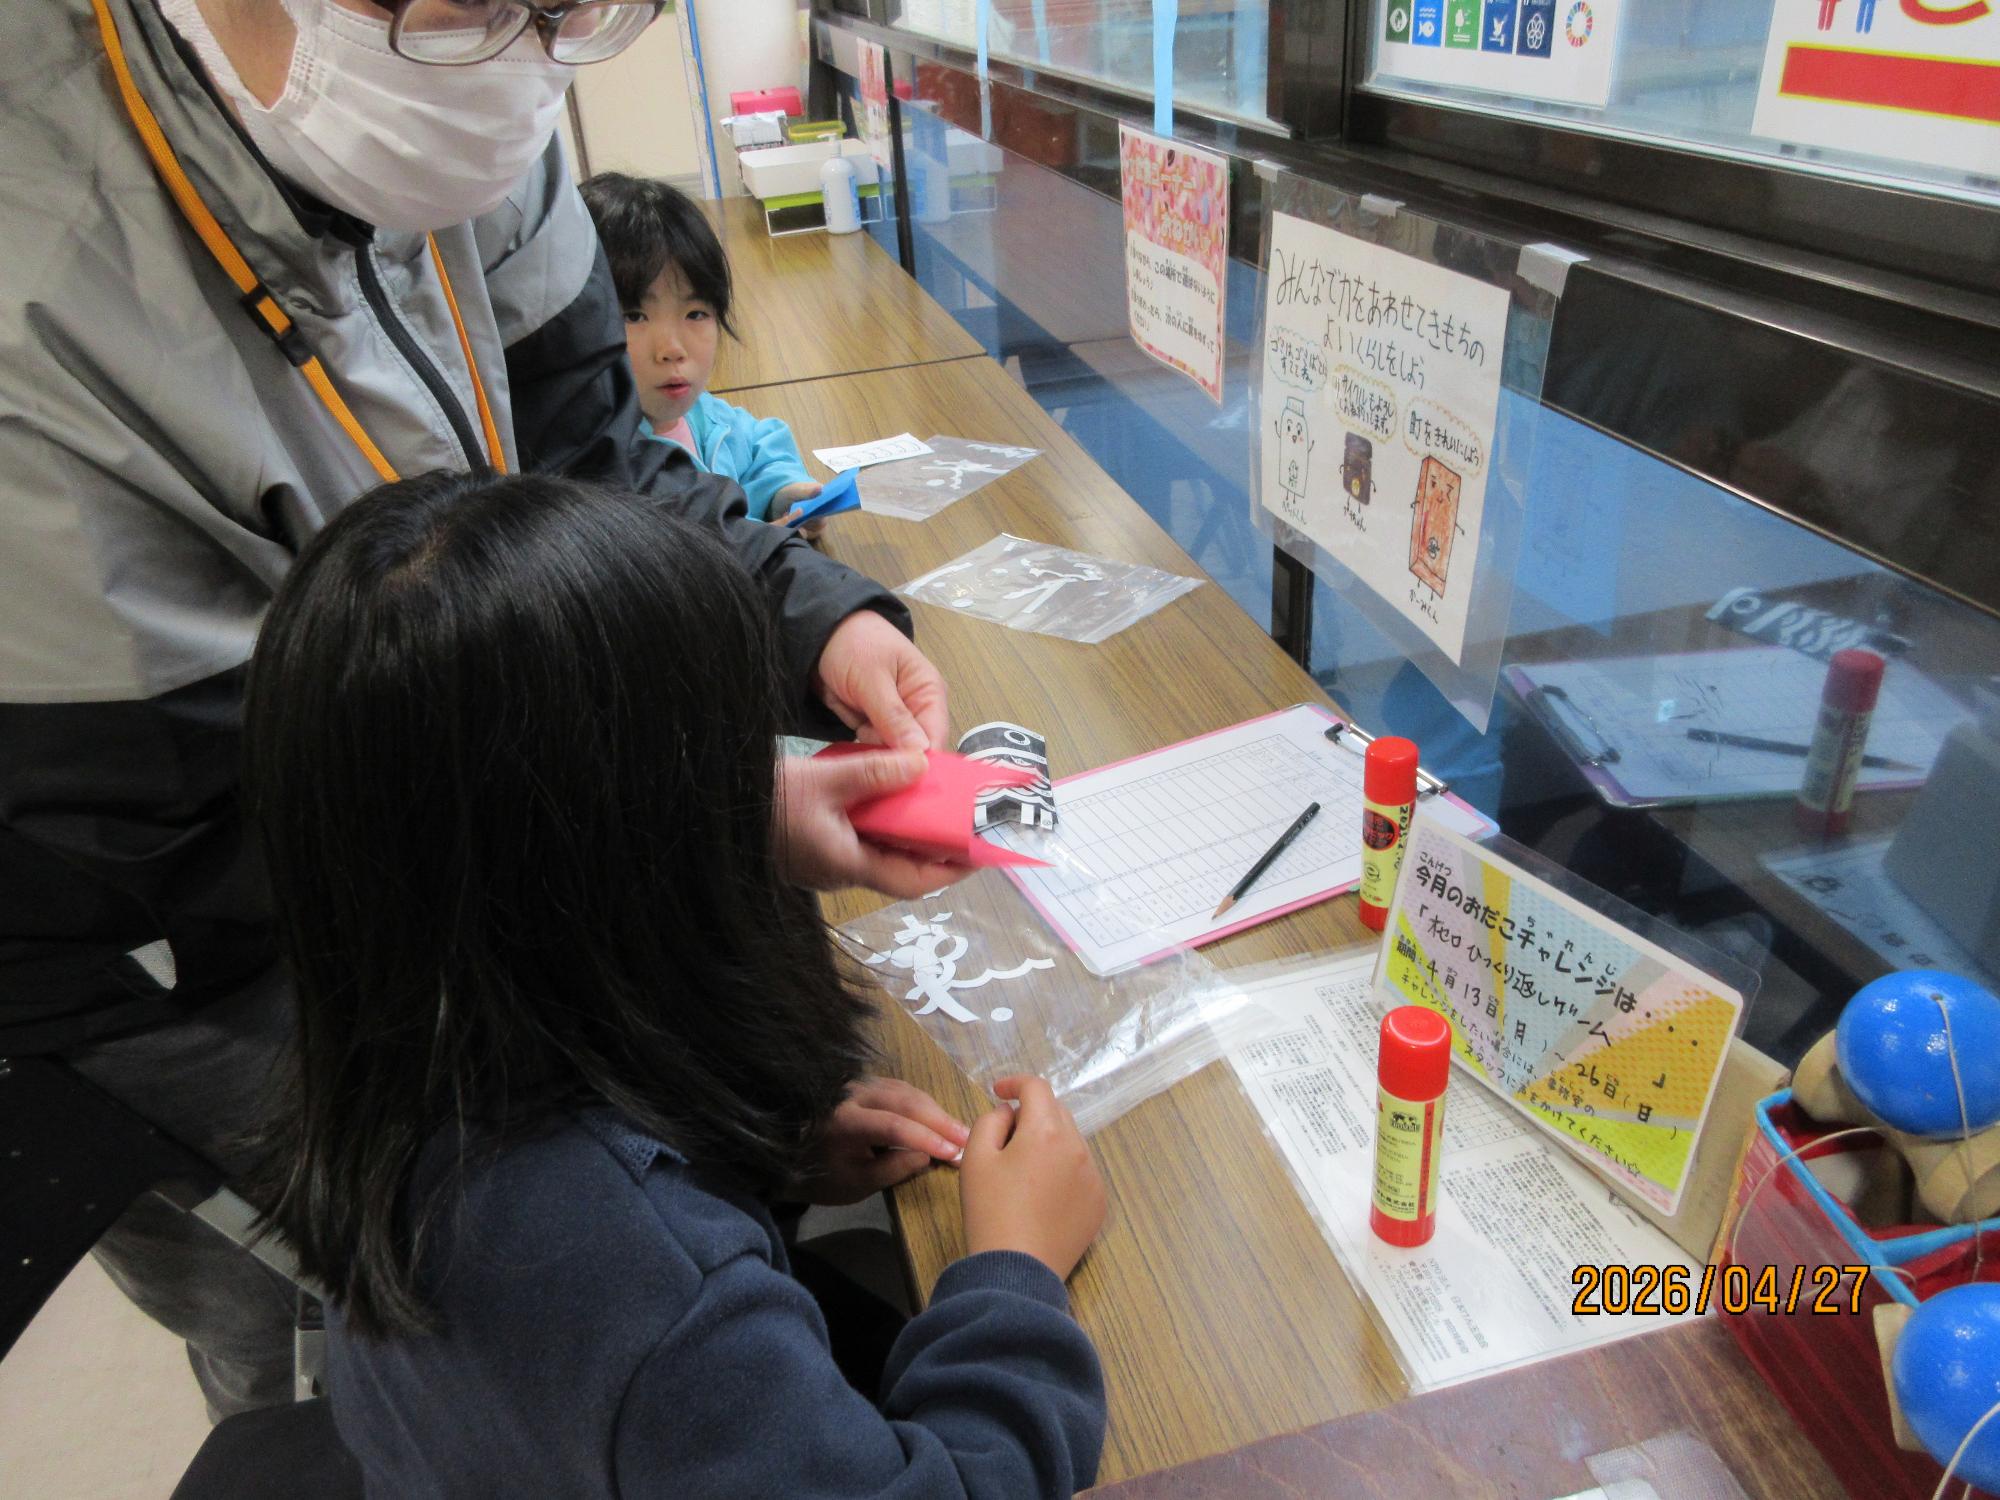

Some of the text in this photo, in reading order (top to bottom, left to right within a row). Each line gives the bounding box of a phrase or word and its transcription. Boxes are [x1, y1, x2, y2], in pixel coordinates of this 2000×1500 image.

[1275, 248, 1485, 367] みんなで力をあわせてきもちの
[1323, 313, 1425, 390] よいくらしをしよう
